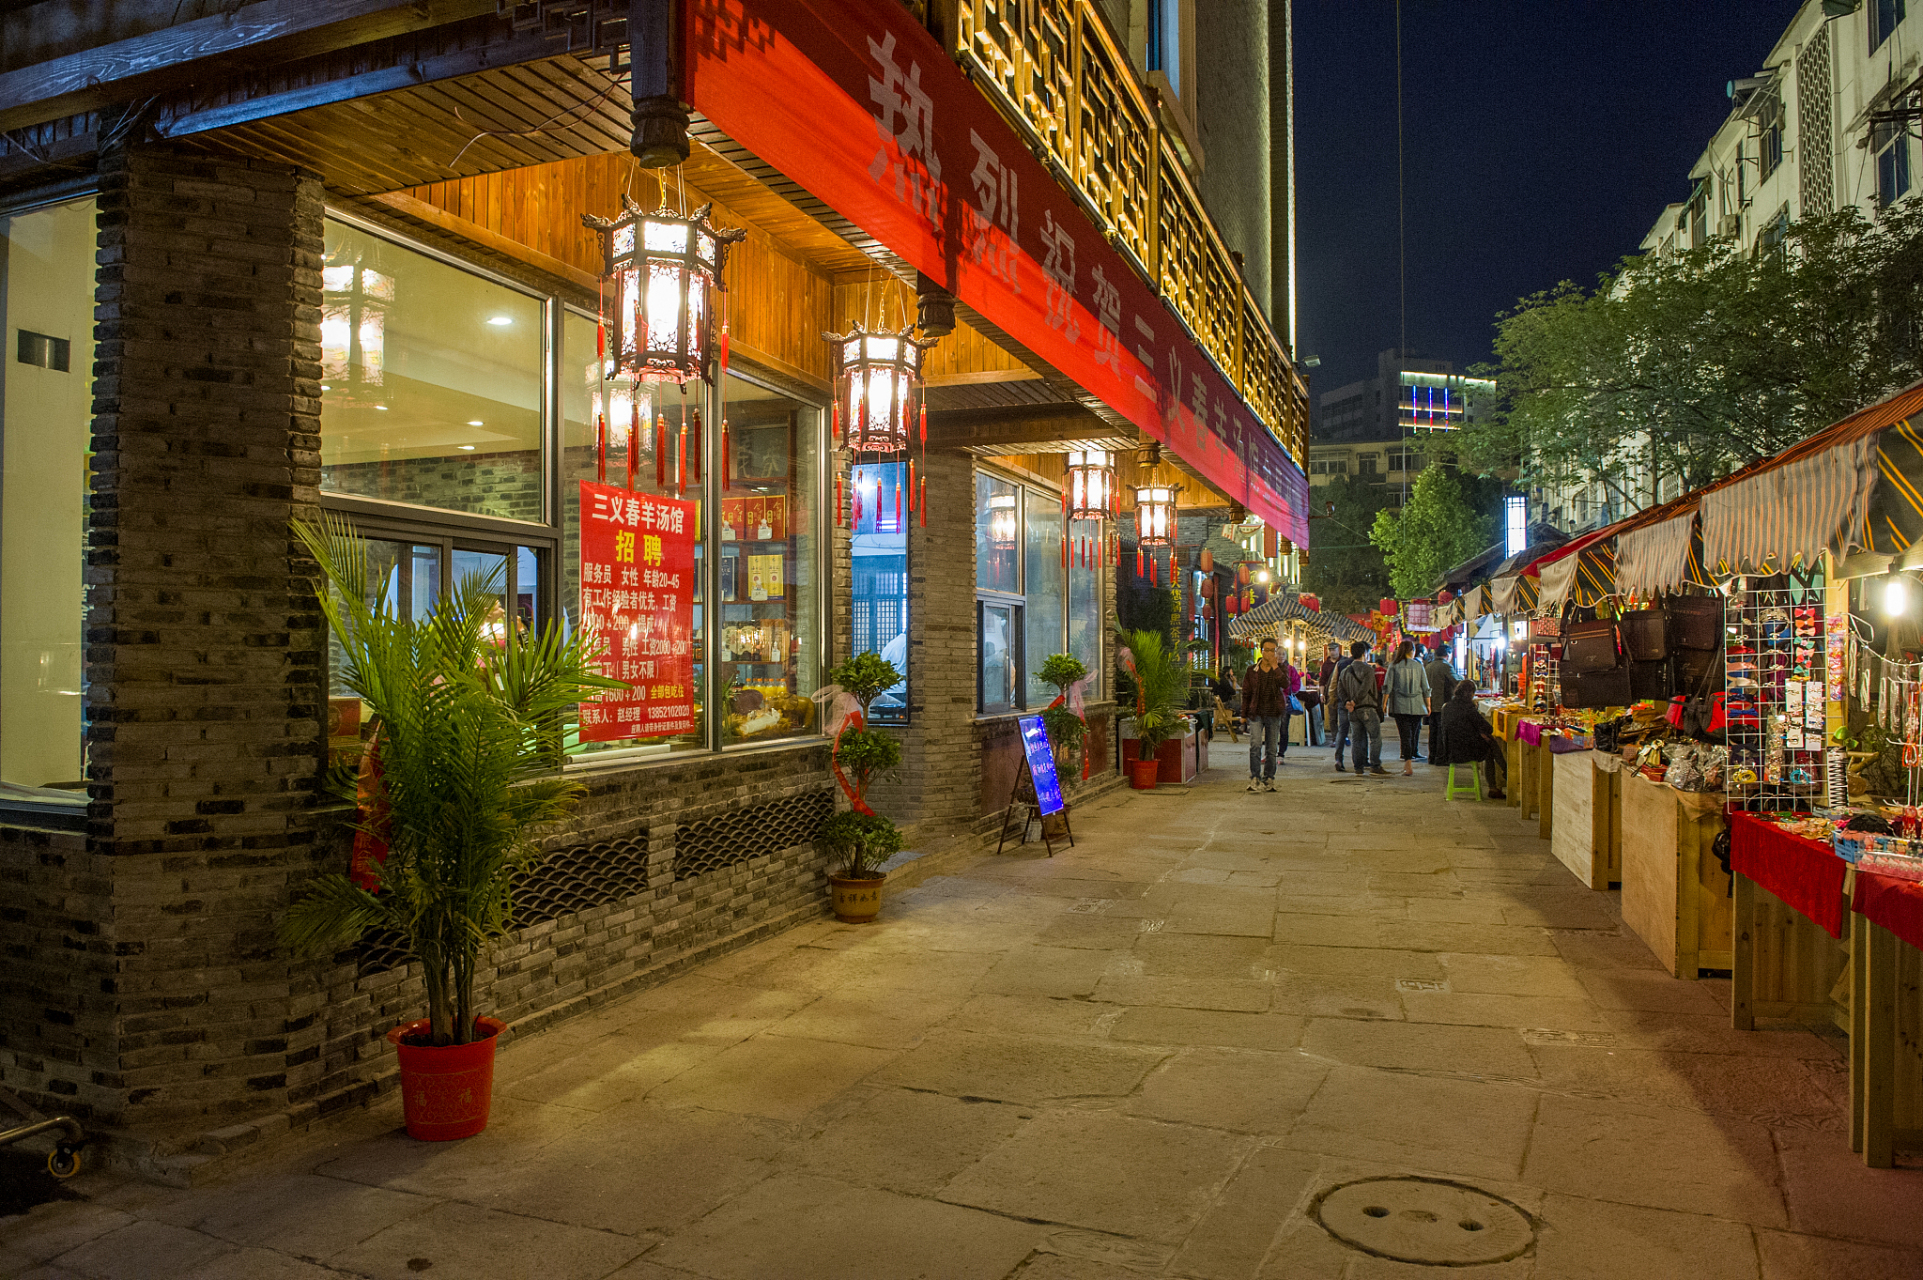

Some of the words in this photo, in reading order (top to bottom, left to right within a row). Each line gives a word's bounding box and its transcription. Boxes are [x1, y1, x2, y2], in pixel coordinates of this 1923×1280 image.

[591, 493, 684, 534] 三义春羊汤馆
[615, 529, 662, 567] 招聘
[583, 562, 612, 584] 服务员
[621, 566, 639, 587] 女性
[643, 568, 680, 589] 年龄20-45
[622, 636, 639, 657] 男性
[650, 684, 685, 700] 全部包吃住
[582, 706, 641, 725] 联系人：赵经理
